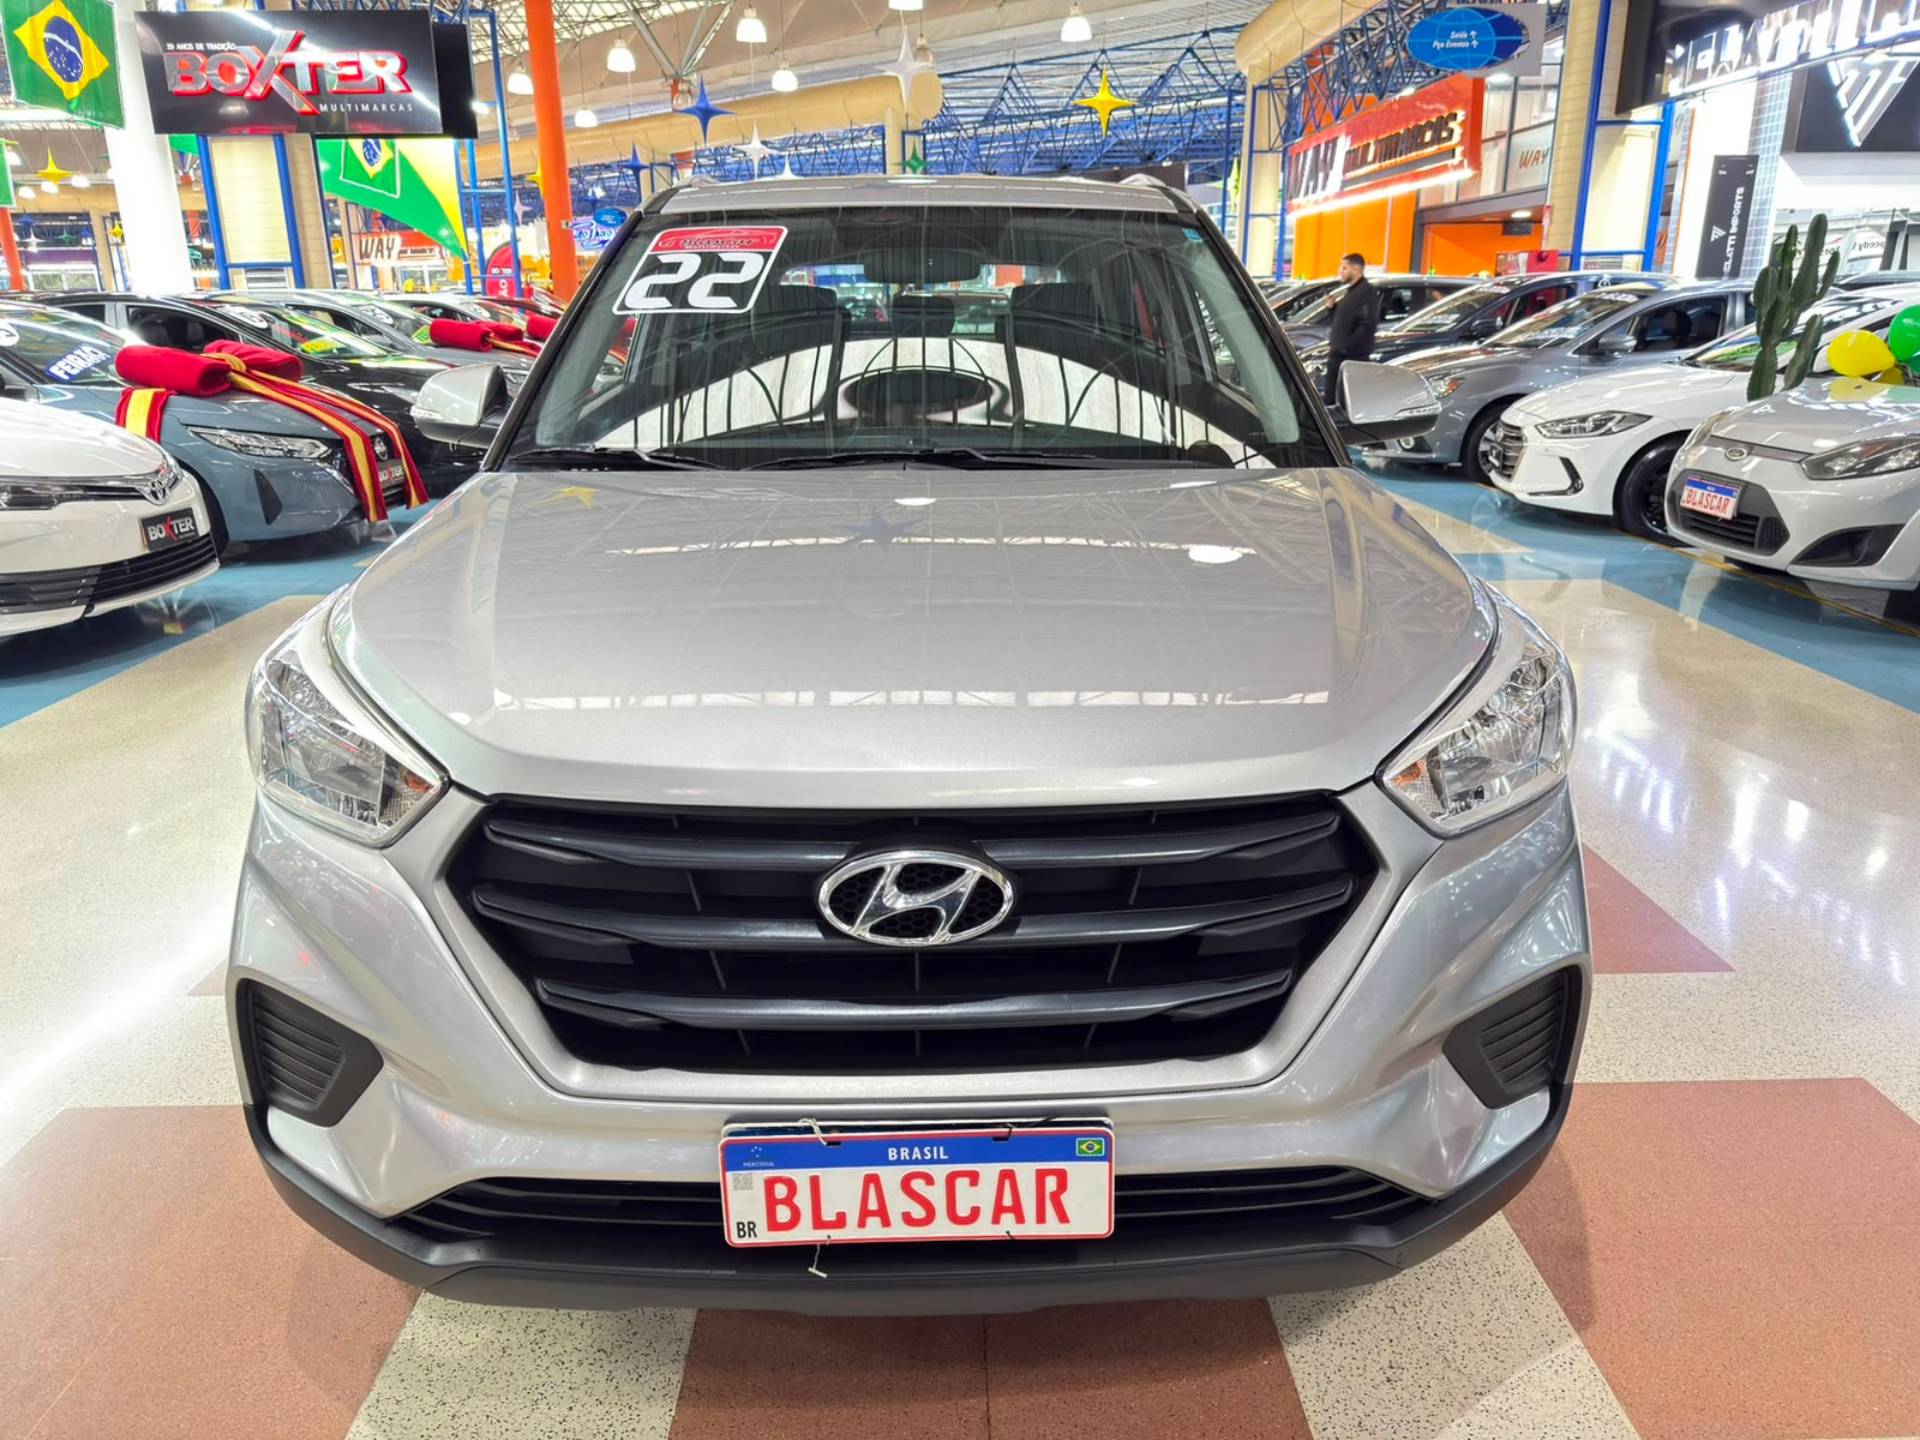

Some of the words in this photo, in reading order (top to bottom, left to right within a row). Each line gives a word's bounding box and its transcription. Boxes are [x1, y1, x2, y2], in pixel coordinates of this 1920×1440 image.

[163, 30, 413, 115] BOXTER
[319, 103, 413, 113] MULTIMARCAS
[1288, 136, 1338, 199] WAY
[1519, 147, 1550, 169] WAY
[1729, 186, 1745, 234] IMPORTS
[360, 237, 396, 259] WAY
[625, 252, 764, 309] 22
[1685, 489, 1730, 514] BLASCAR
[147, 514, 194, 544] BOXTER
[888, 1146, 948, 1161] BRASIL
[763, 1168, 1070, 1232] BLASCAR
[737, 1221, 757, 1239] BR
